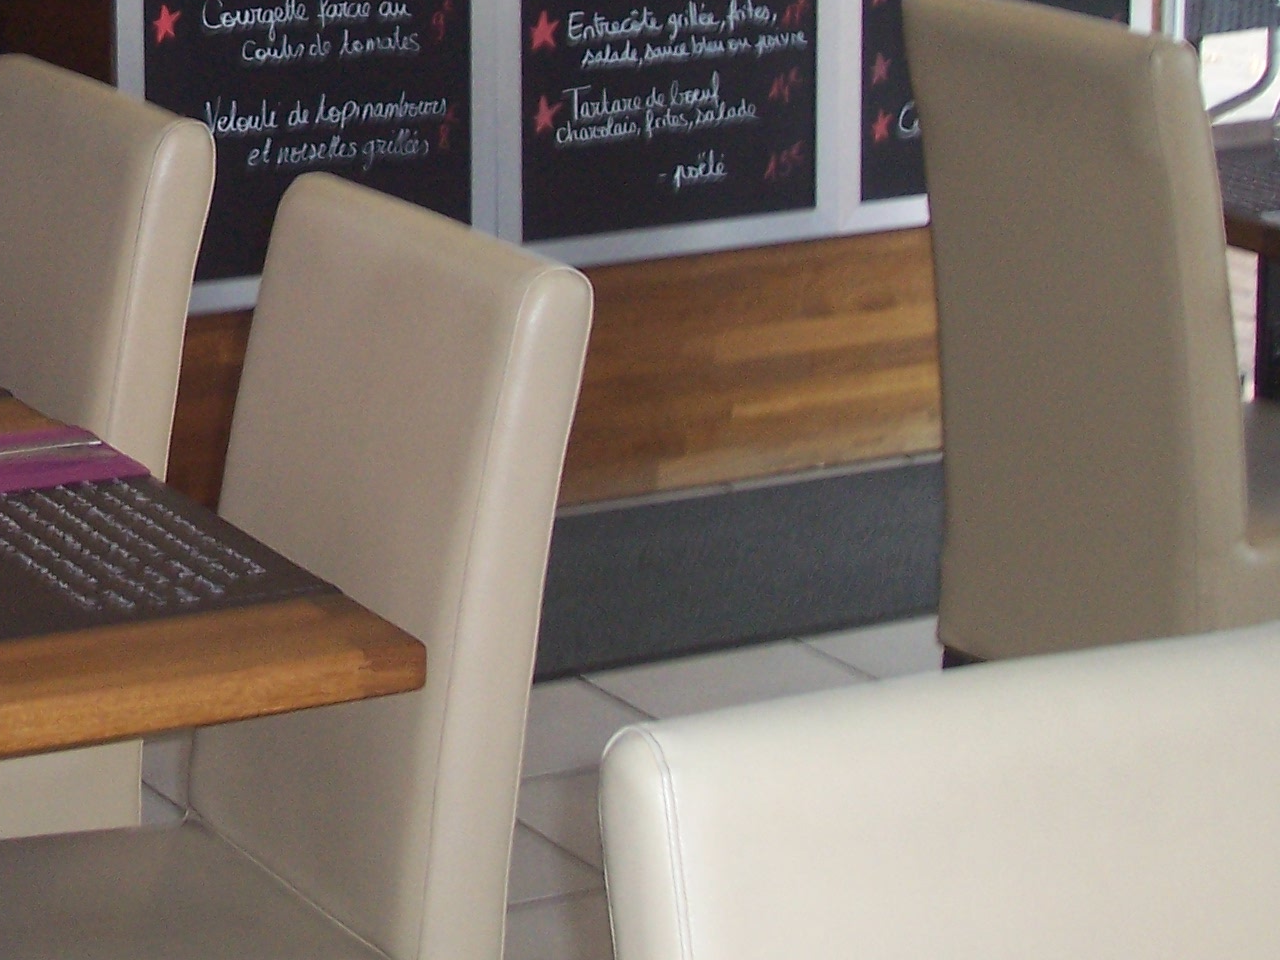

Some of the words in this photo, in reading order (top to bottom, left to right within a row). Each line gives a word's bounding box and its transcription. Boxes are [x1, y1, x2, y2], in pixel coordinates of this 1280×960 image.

[378, 0, 412, 18] au
[308, 34, 330, 56] de
[728, 36, 751, 52] ou
[288, 98, 309, 126] de
[562, 85, 641, 121] Tartare
[644, 86, 665, 108] de
[247, 137, 271, 167] et
